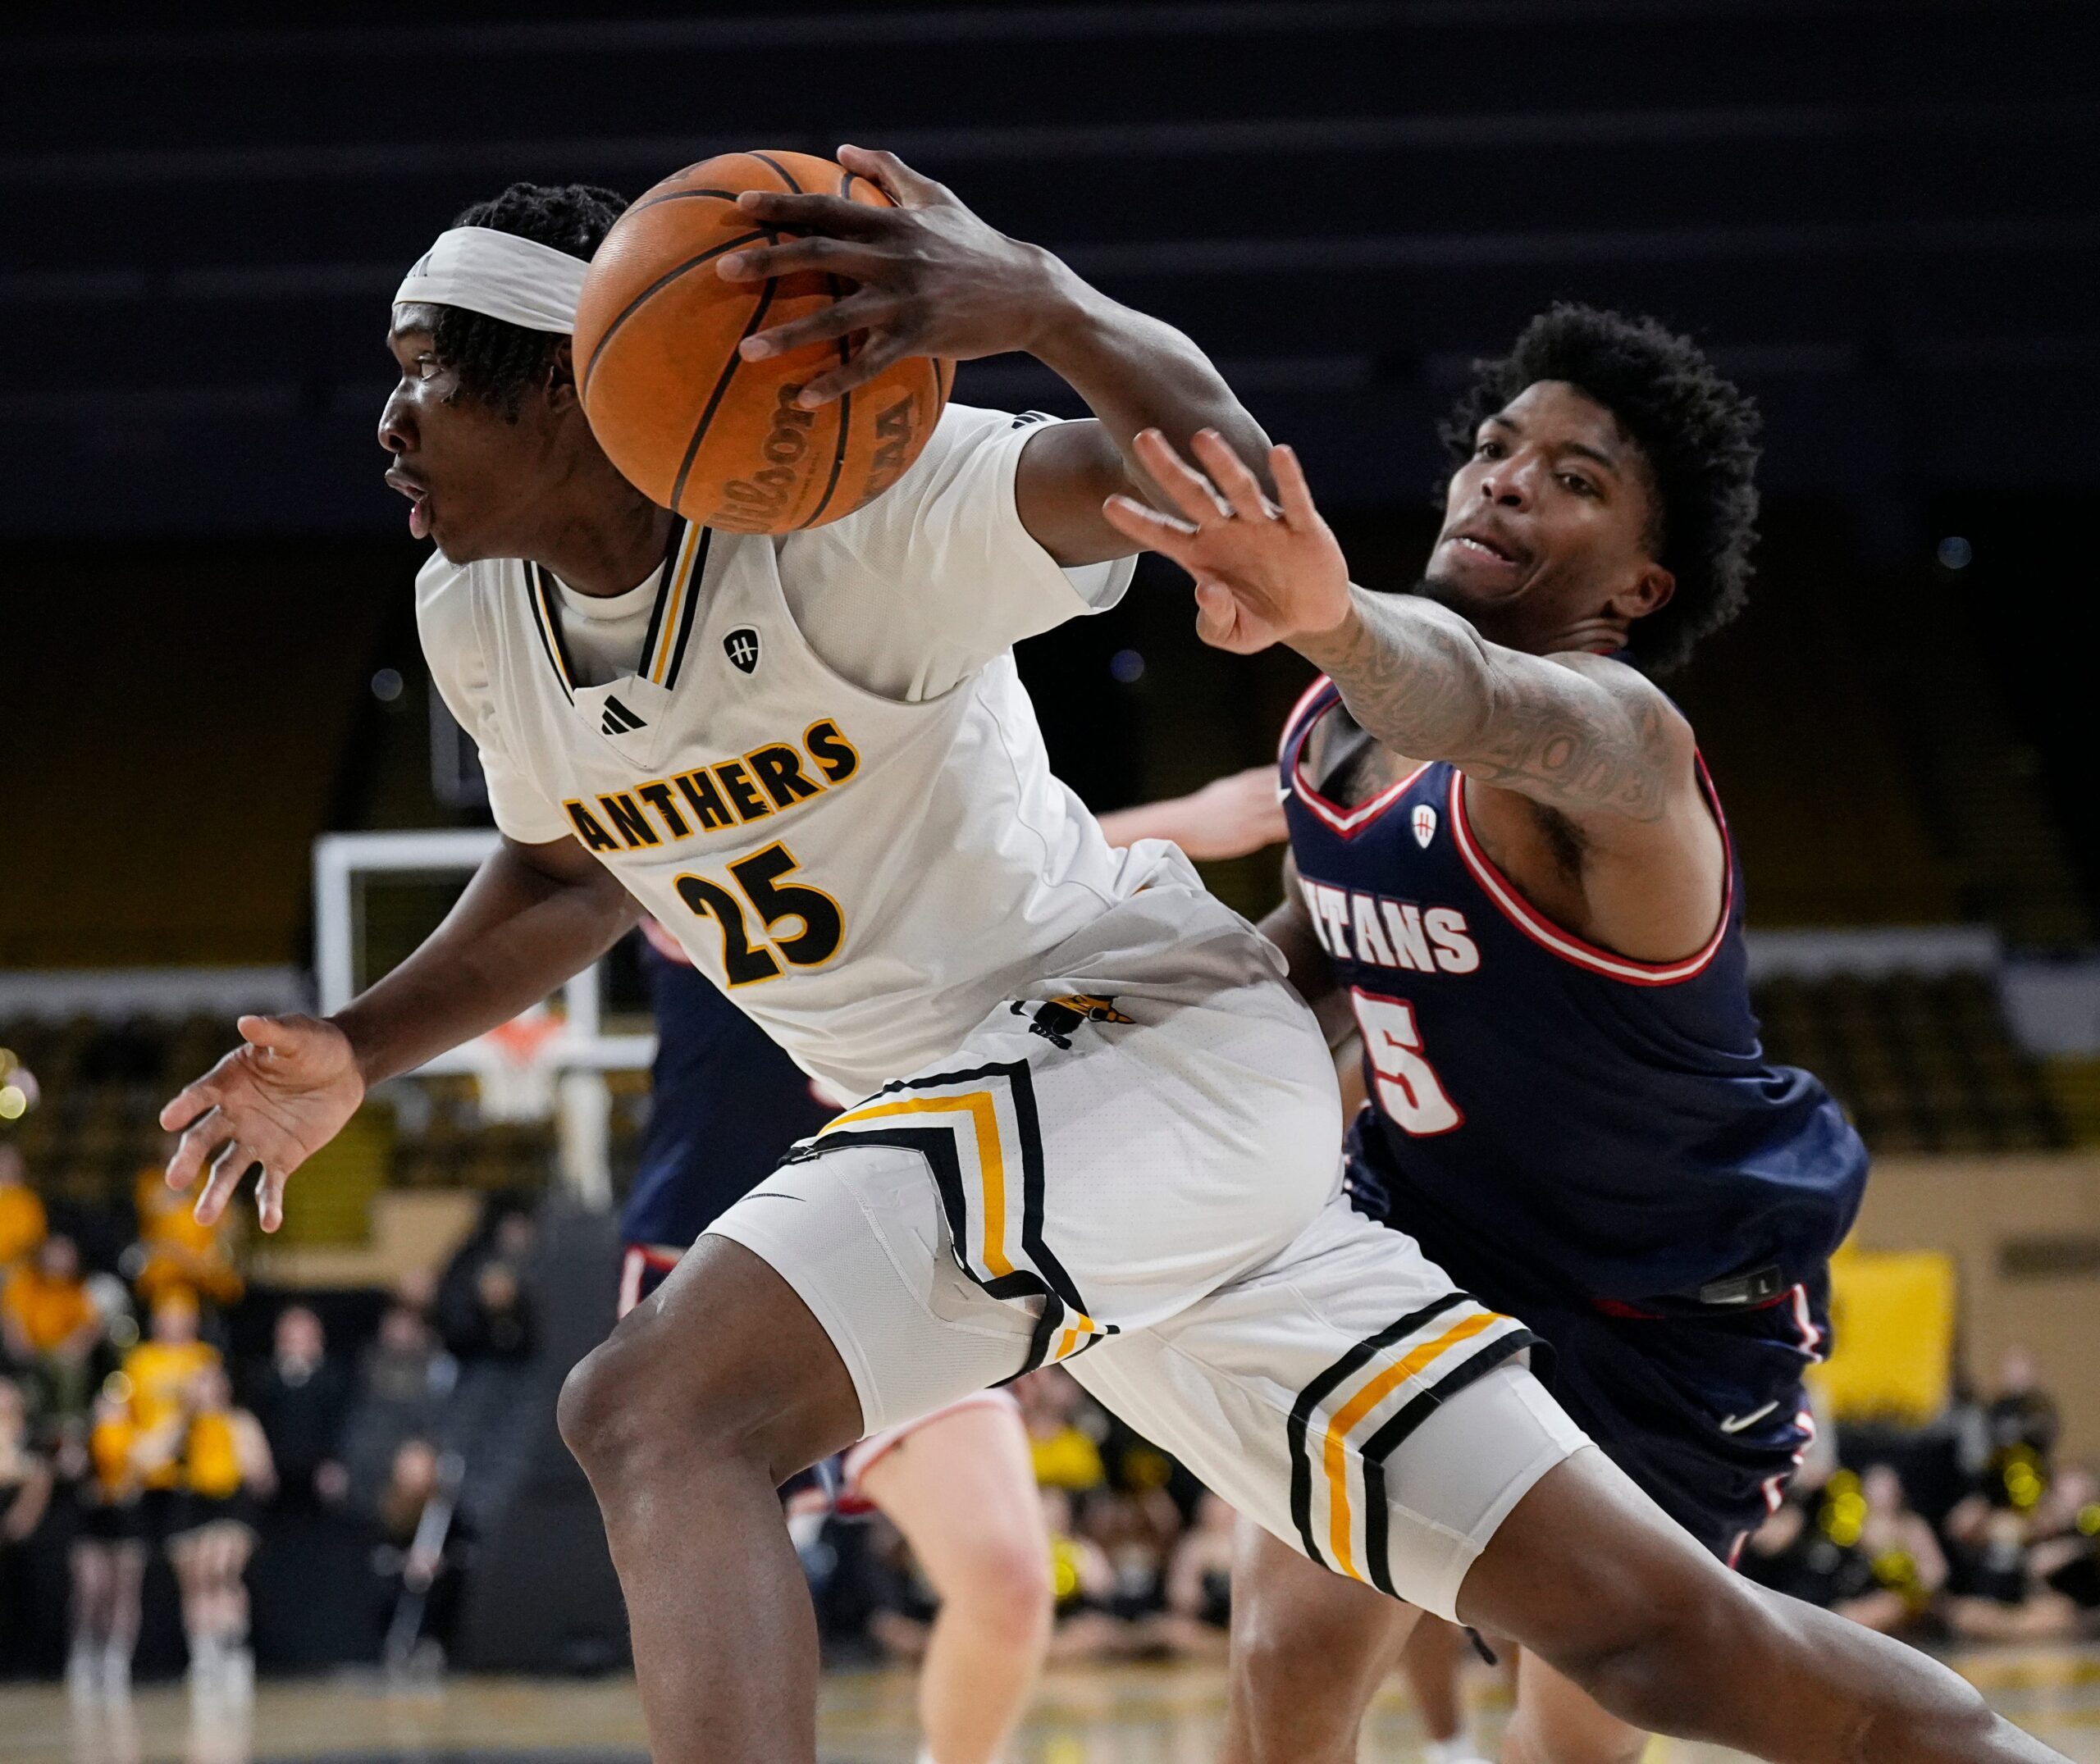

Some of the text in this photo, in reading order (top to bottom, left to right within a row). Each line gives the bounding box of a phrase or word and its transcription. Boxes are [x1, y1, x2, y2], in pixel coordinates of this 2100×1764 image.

[562, 717, 861, 853] ANTHERS
[672, 840, 845, 989] 25
[1298, 877, 1481, 974] ITANS
[1350, 984, 1467, 1138] 5
